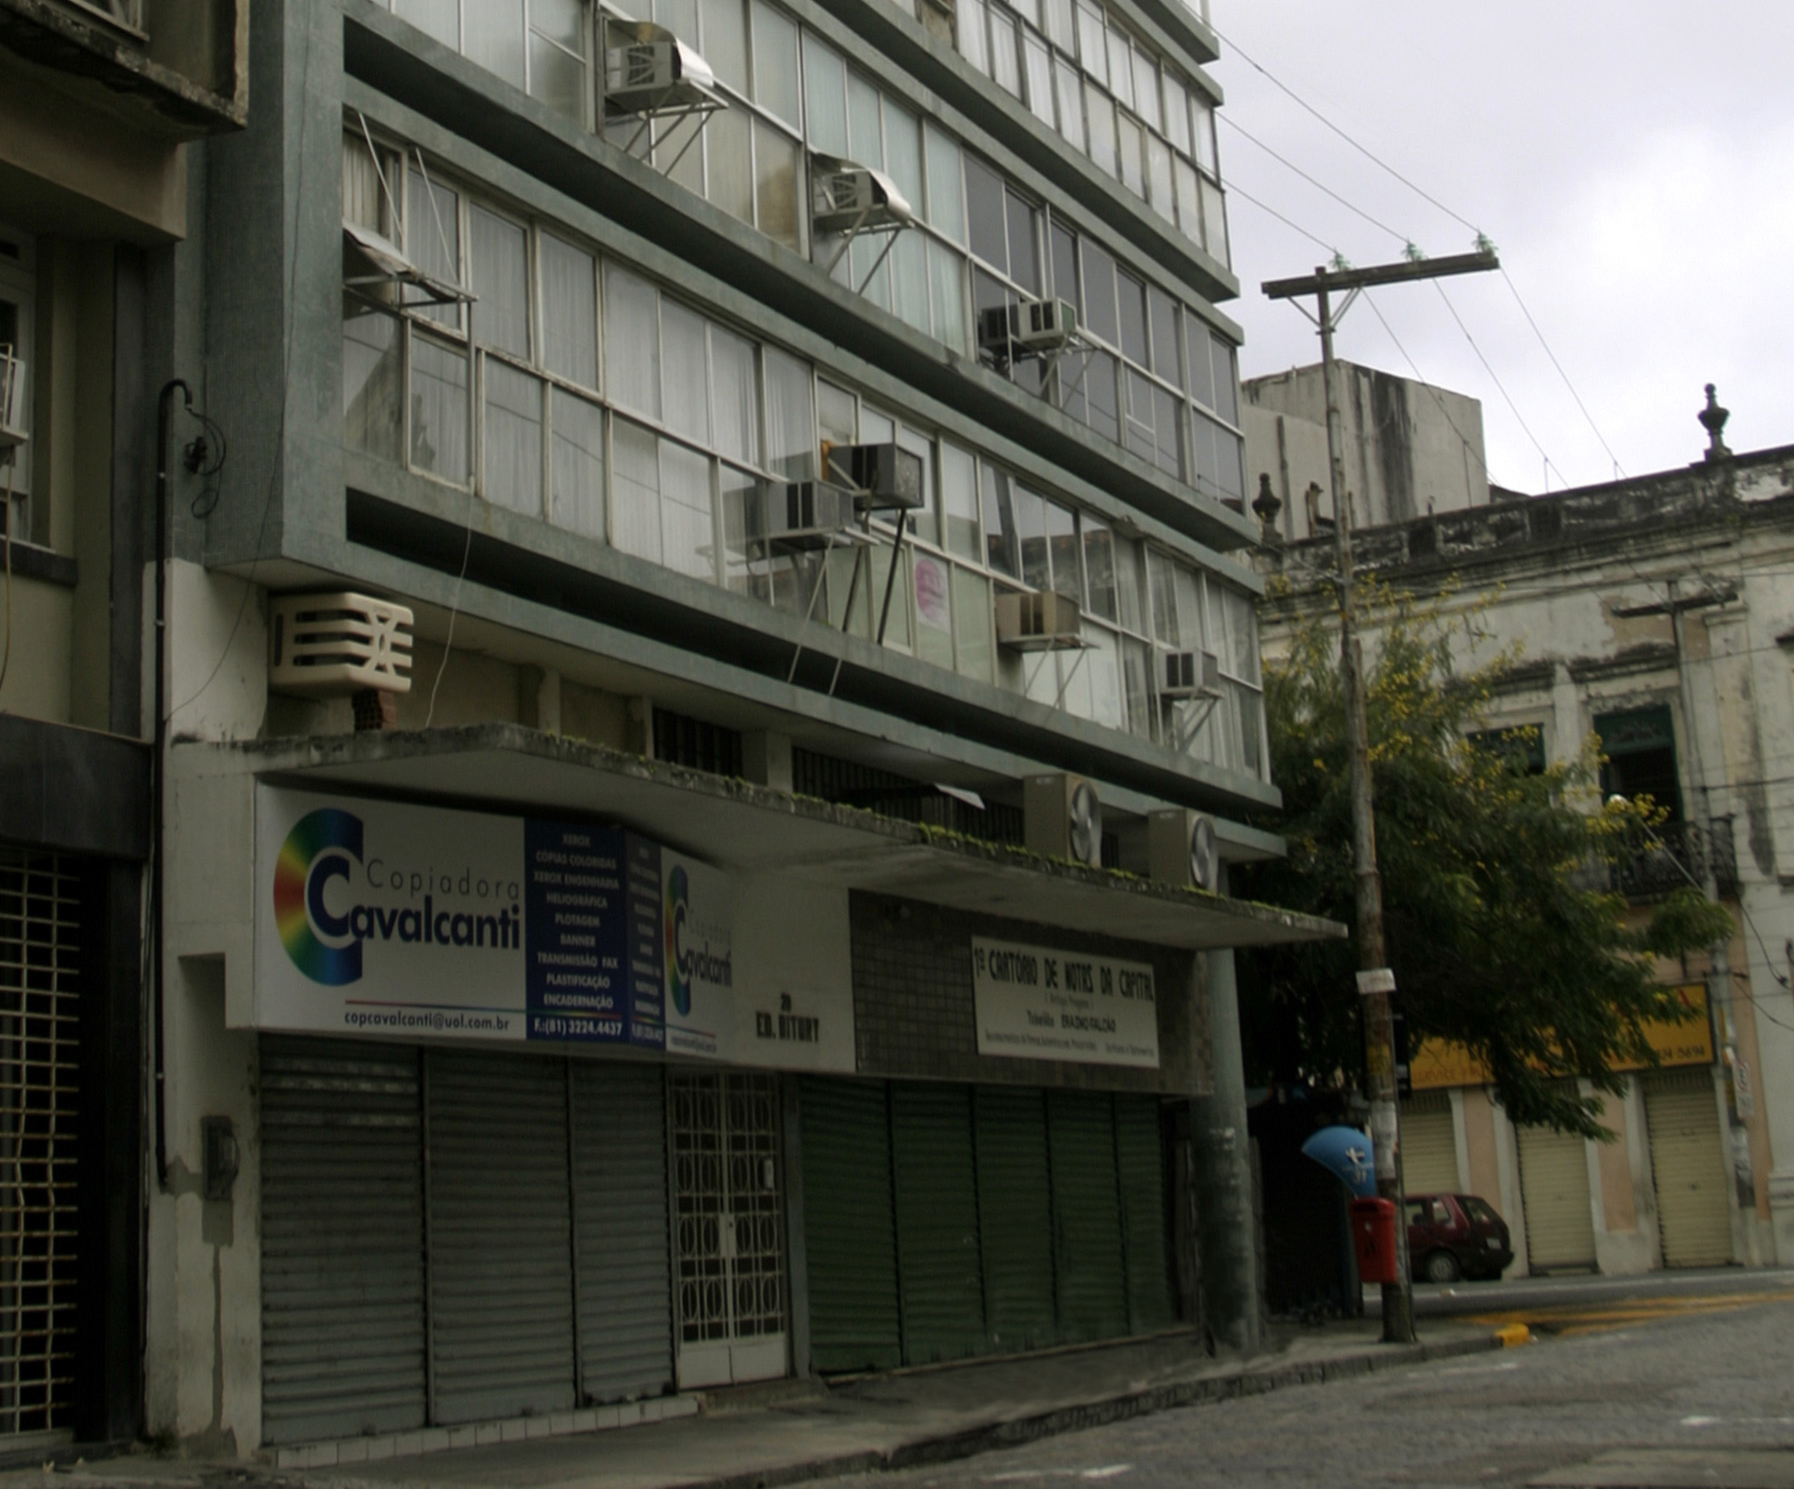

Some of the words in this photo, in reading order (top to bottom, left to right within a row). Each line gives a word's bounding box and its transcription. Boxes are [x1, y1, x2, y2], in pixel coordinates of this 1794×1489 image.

[562, 833, 590, 847] XEROX
[536, 849, 567, 865] CÓPIAS
[569, 854, 616, 870] COLORIDAS
[367, 858, 519, 900] Copiadora
[534, 871, 562, 885] XEROX
[564, 873, 619, 890] ENGENHARIA
[308, 855, 520, 949] Cavalcanti
[546, 892, 608, 909] HELIOGRÁFICA
[555, 913, 600, 927] PLOTAGEM
[560, 933, 595, 947] BANNER
[675, 904, 732, 987] Cavalcanti
[537, 952, 597, 968] TRANSMISSÃO
[602, 957, 618, 969] FAX
[546, 973, 610, 990] PLASTIFICAÇÃO
[989, 949, 1038, 986] CARTÓRIO
[1044, 957, 1058, 988] DE
[1064, 961, 1094, 993] NOTAS
[1100, 966, 1113, 996] DA
[1119, 968, 1154, 1001] CAPITAL
[544, 993, 614, 1011] ENCADERNAÇÃO
[345, 1011, 509, 1030] copcavalcanti@uol.com.br
[569, 1019, 622, 1037] 3224.4437
[756, 1011, 776, 1039] ED.
